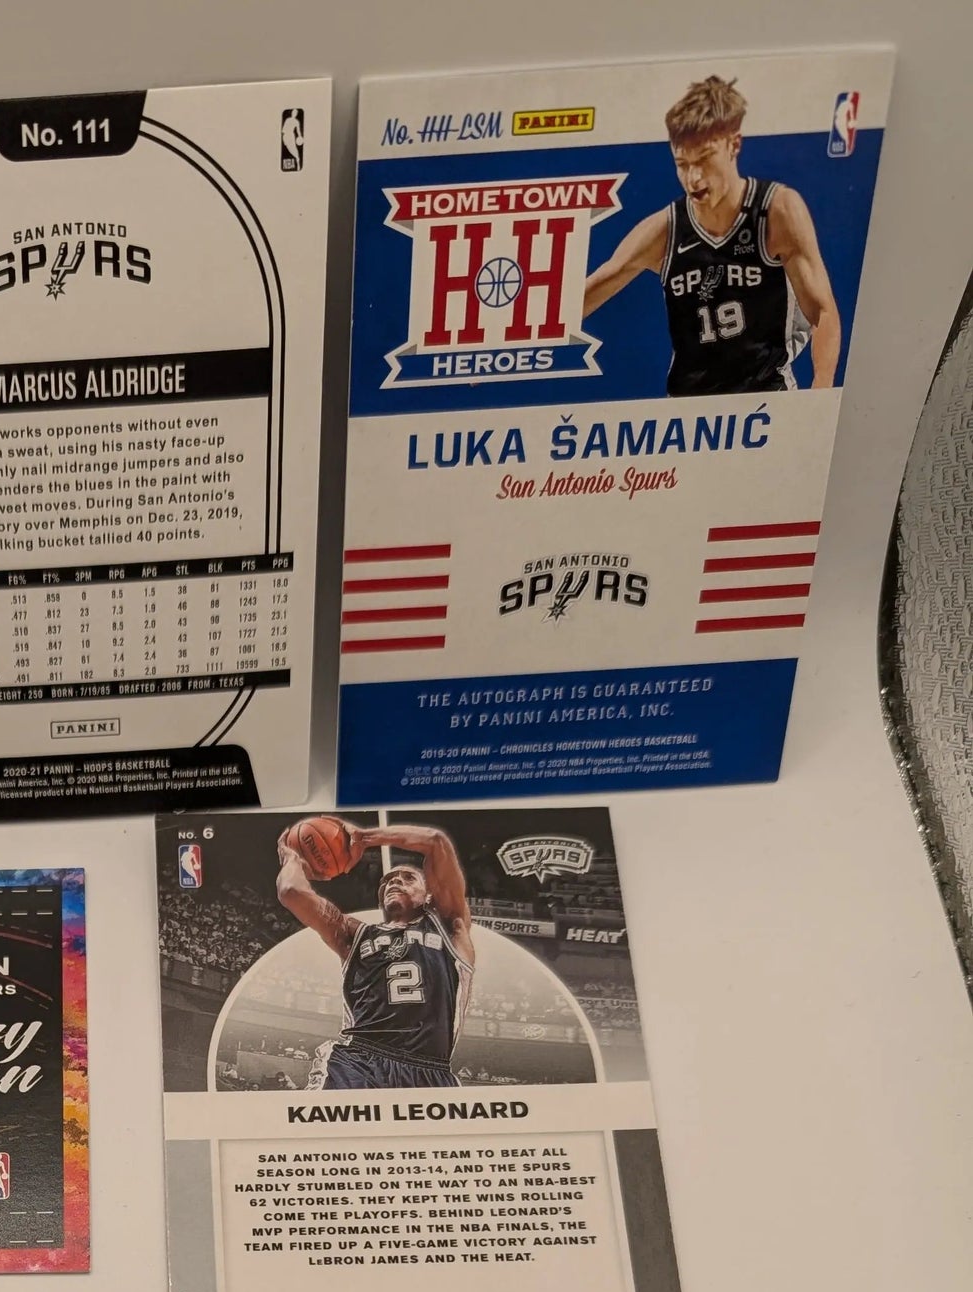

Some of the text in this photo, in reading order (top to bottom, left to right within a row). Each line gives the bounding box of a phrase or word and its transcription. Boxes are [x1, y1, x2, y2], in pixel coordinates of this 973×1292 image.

[21, 119, 111, 147] No. 111
[382, 119, 414, 146] No.
[518, 113, 589, 130] PANINI
[410, 181, 599, 217] HOMETOWN
[13, 222, 126, 244] SAN ANTONIO
[669, 264, 762, 301] SPURS
[697, 301, 745, 343] 19
[431, 350, 554, 377] HEROES
[85, 365, 185, 399] ALDRIDGE
[0, 425, 42, 441] works
[46, 422, 123, 439] opponents
[127, 417, 182, 432] without
[186, 415, 218, 429] even
[407, 403, 771, 470] LUKA ŠAMANIĆ
[495, 466, 678, 500] San Antonio Spurs
[8, 575, 27, 585] FG%
[42, 573, 60, 584] FT%
[74, 571, 92, 582] 3PM
[108, 568, 125, 580] RPG
[524, 554, 629, 574] SAN ANTONIO
[498, 569, 649, 627] SPURS
[417, 678, 713, 708] THE AUTOGRAPH IS GUARANTEED
[56, 721, 116, 735] PANINI
[178, 827, 214, 840] NO. 6
[509, 848, 581, 872] SPURS
[494, 919, 539, 933] SPORTS
[566, 928, 627, 944] HEAT
[386, 960, 424, 1005] 2
[287, 1100, 530, 1125] KAWHI LEONARD
[258, 1148, 567, 1163] SAN ANTONIO WAS THE TEAM TO BEAT ALL
